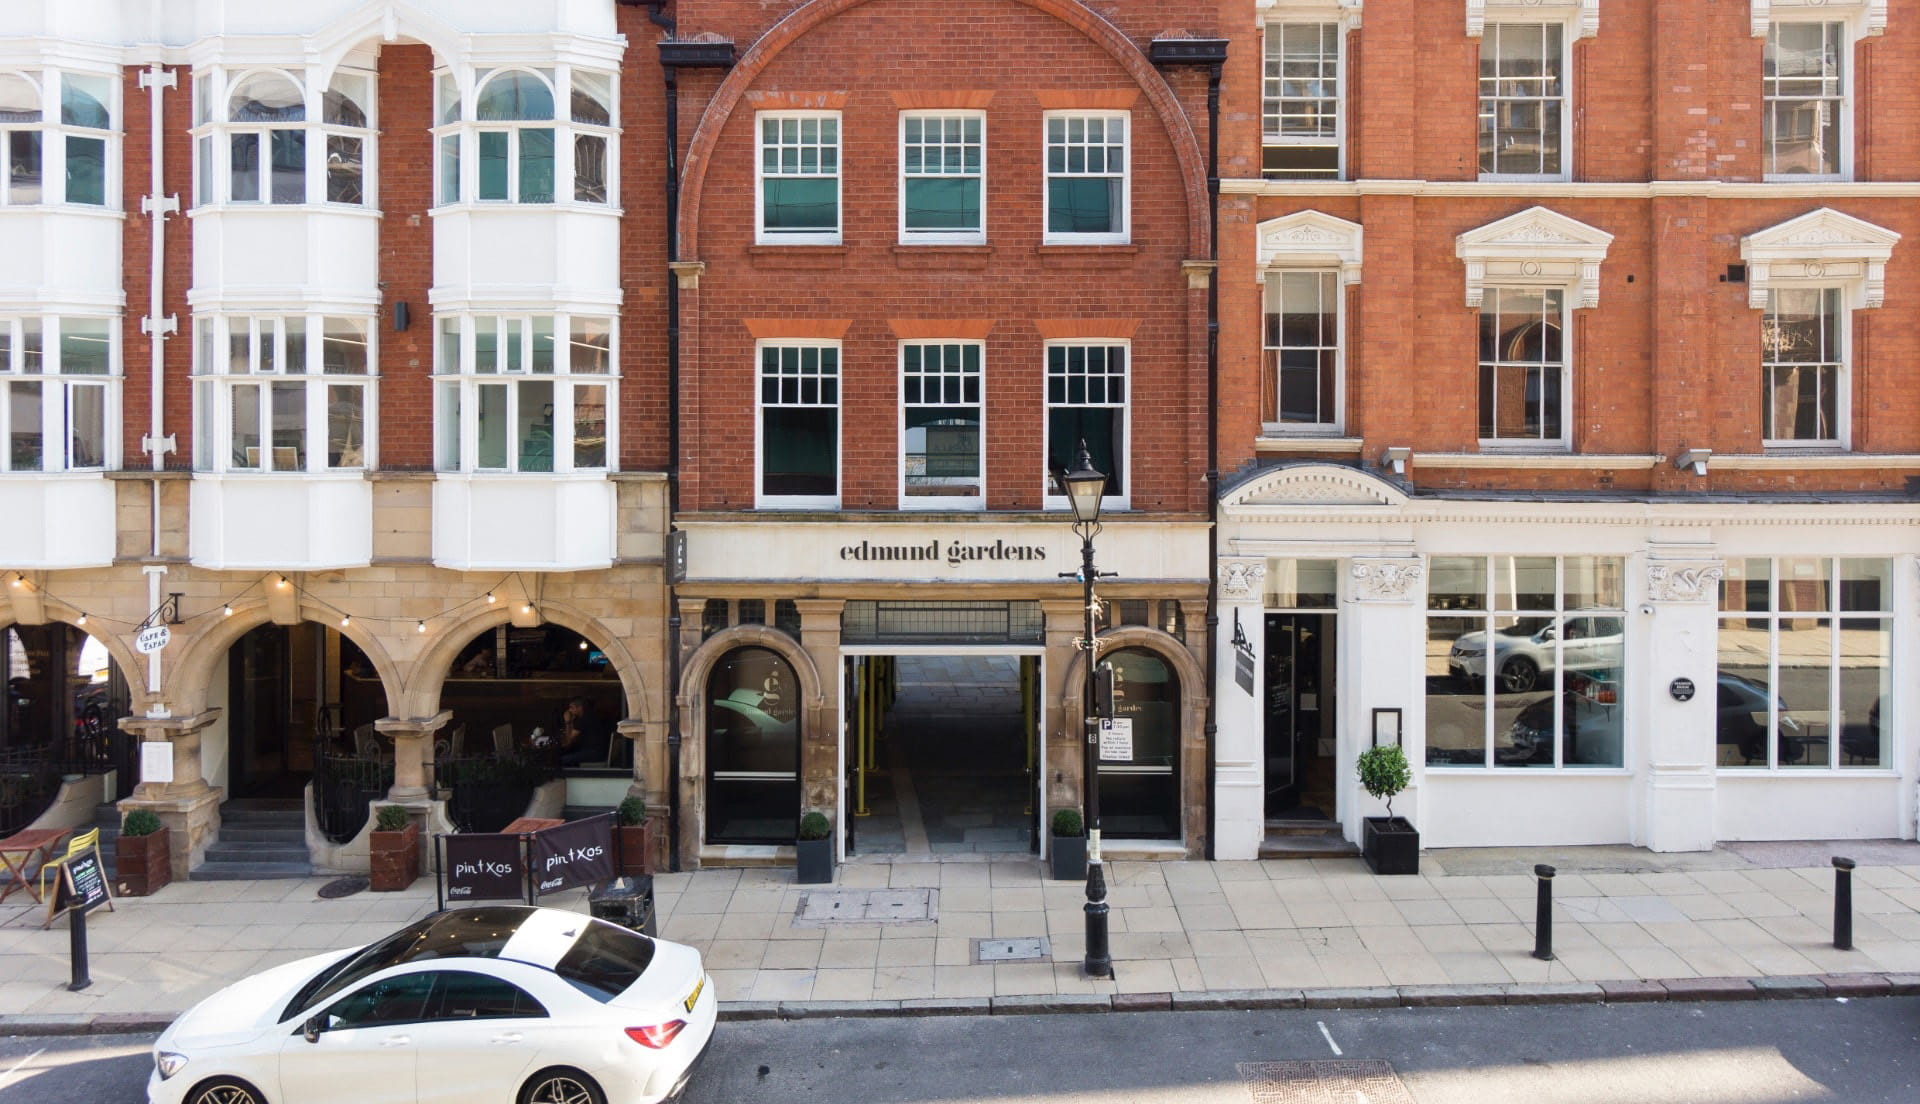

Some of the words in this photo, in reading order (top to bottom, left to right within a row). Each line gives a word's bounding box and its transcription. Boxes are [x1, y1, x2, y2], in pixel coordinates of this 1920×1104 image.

[840, 540, 939, 561] edmund
[947, 540, 1046, 568] gardens
[144, 638, 166, 650] TAPAS
[1103, 720, 1112, 730] P
[546, 845, 603, 871] pintxos
[456, 859, 512, 878] pintxos
